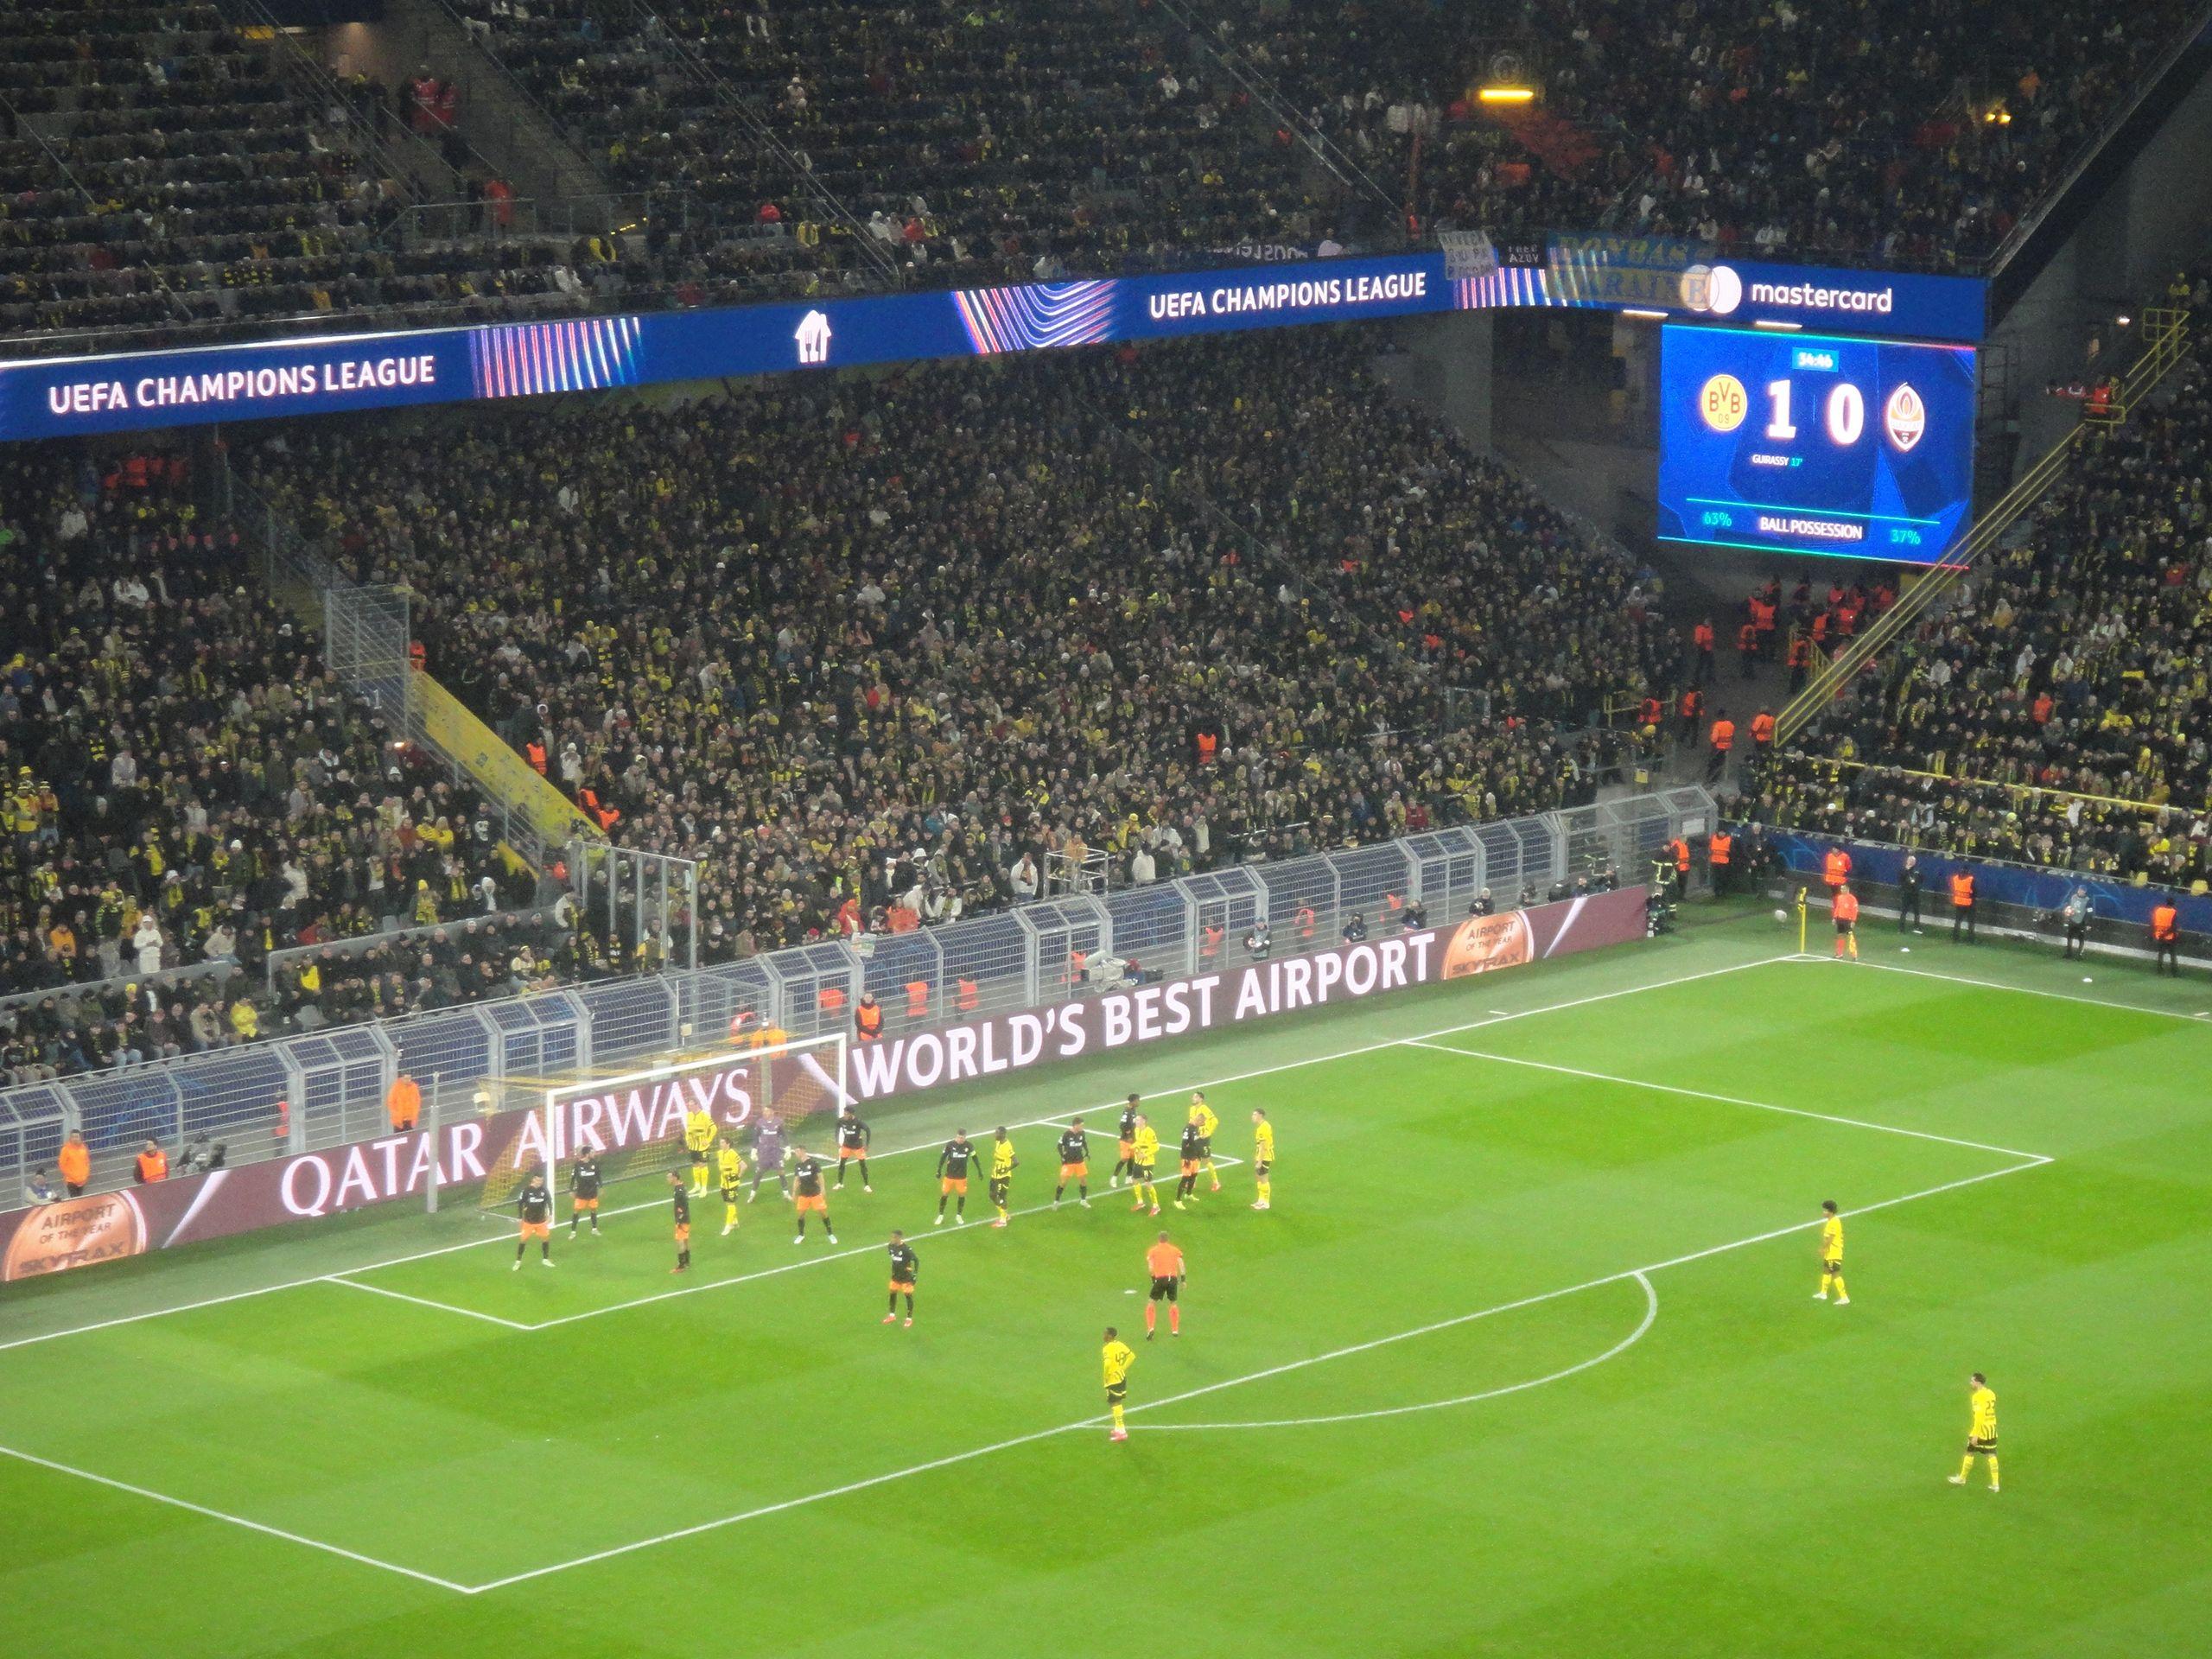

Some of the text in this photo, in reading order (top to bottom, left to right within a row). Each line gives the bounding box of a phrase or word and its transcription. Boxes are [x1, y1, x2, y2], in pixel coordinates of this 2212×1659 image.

[1150, 272, 1427, 319] UEFA CHAMPIONS LEAGUE
[1751, 283, 1892, 313] mastercard
[49, 355, 435, 414] UEFA CHAMPIONS LEAGUE
[1709, 382, 1740, 414] BVB
[1766, 379, 1865, 445] 1 0
[1751, 454, 1789, 466] GUIRASSY
[1702, 512, 1732, 527] 63%
[1759, 517, 1863, 540] BALL POSSESSION
[1891, 530, 1921, 545] 37%
[1468, 921, 1516, 940] AIRPORT
[852, 932, 1436, 1098] WORLD'S BEST AIRPORT
[282, 1068, 752, 1217] QATAR AIRWAYS
[41, 1203, 117, 1230] AIRPORT
[40, 1233, 54, 1245] OF
